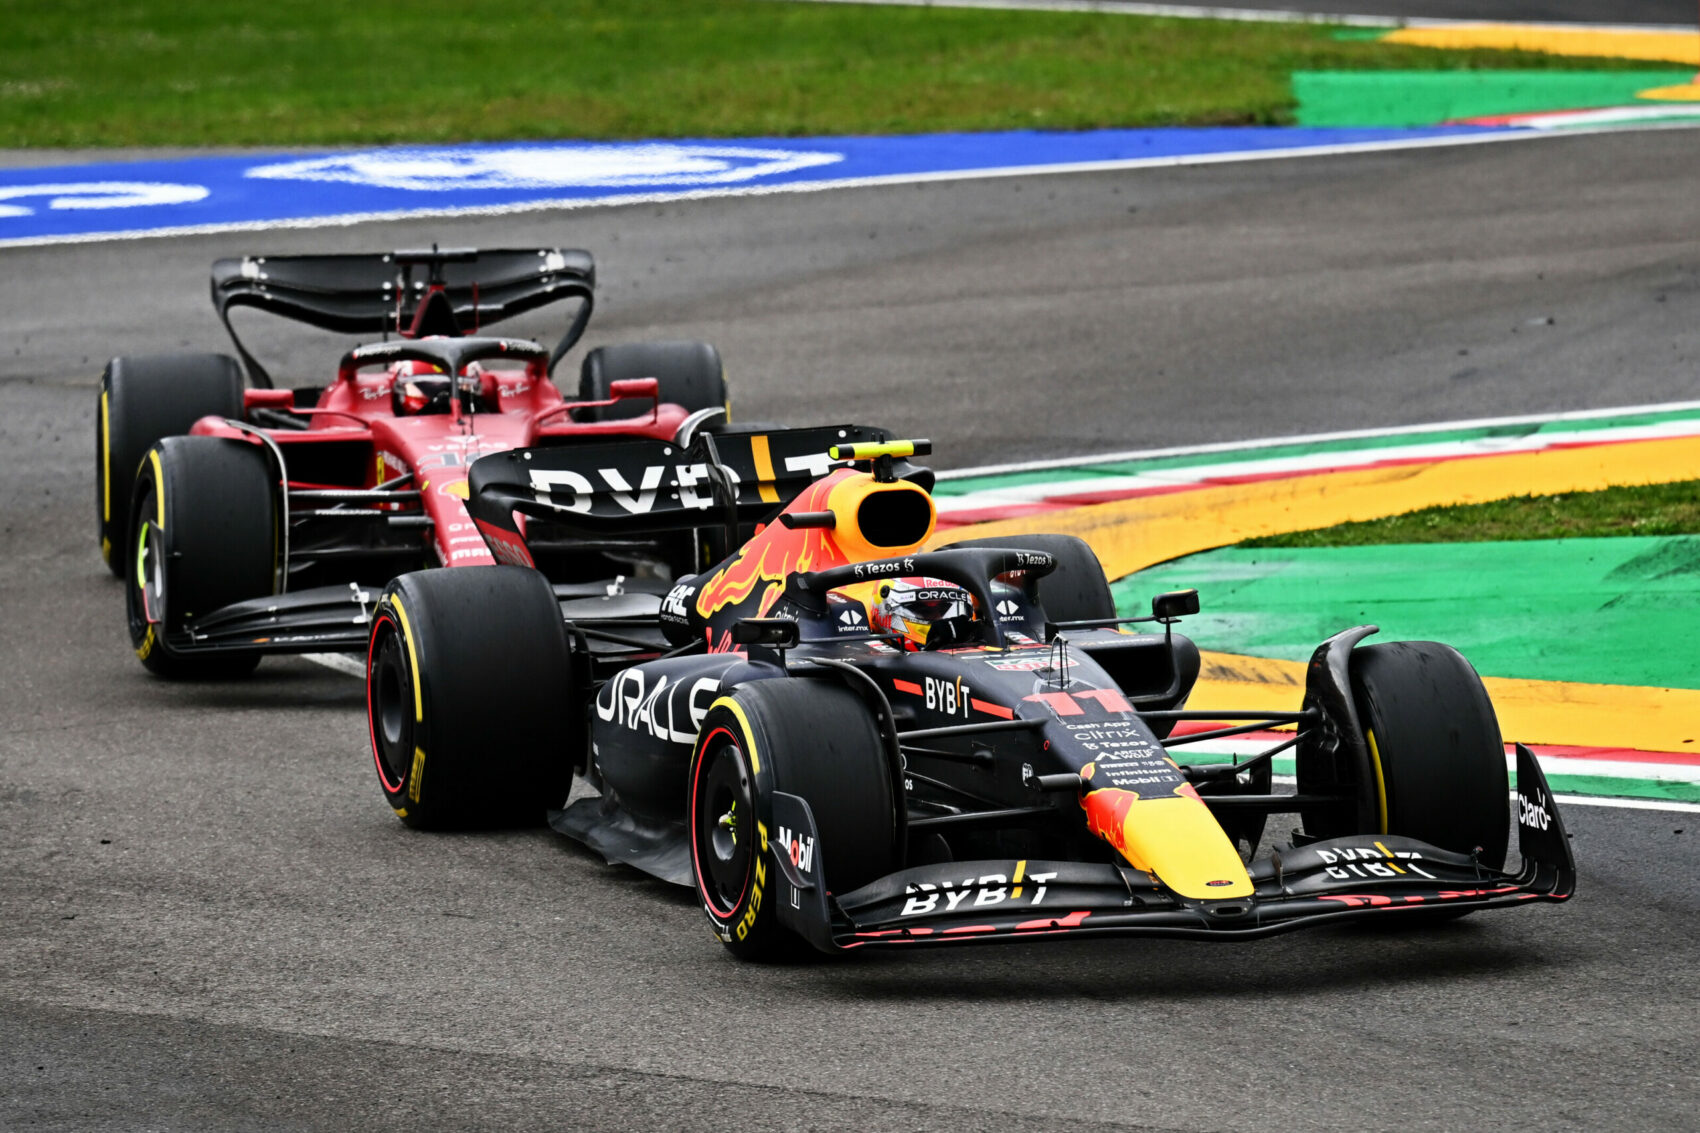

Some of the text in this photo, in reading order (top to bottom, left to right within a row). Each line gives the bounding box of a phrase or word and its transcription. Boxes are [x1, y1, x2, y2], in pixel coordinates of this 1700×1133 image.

[1024, 552, 1047, 565] Tezos
[867, 563, 900, 574] Tezos
[926, 579, 944, 588] Red
[918, 591, 967, 602] ORACLE
[838, 625, 868, 633] inter.mx
[925, 675, 970, 719] BYBIT
[1022, 689, 1134, 717] 11
[1100, 740, 1148, 748] Tezos
[1112, 775, 1161, 786] Mobil
[1518, 788, 1549, 831] Claro
[777, 825, 815, 874] Mobil
[901, 859, 1058, 916] BYBIT
[736, 855, 767, 942] ZERO
